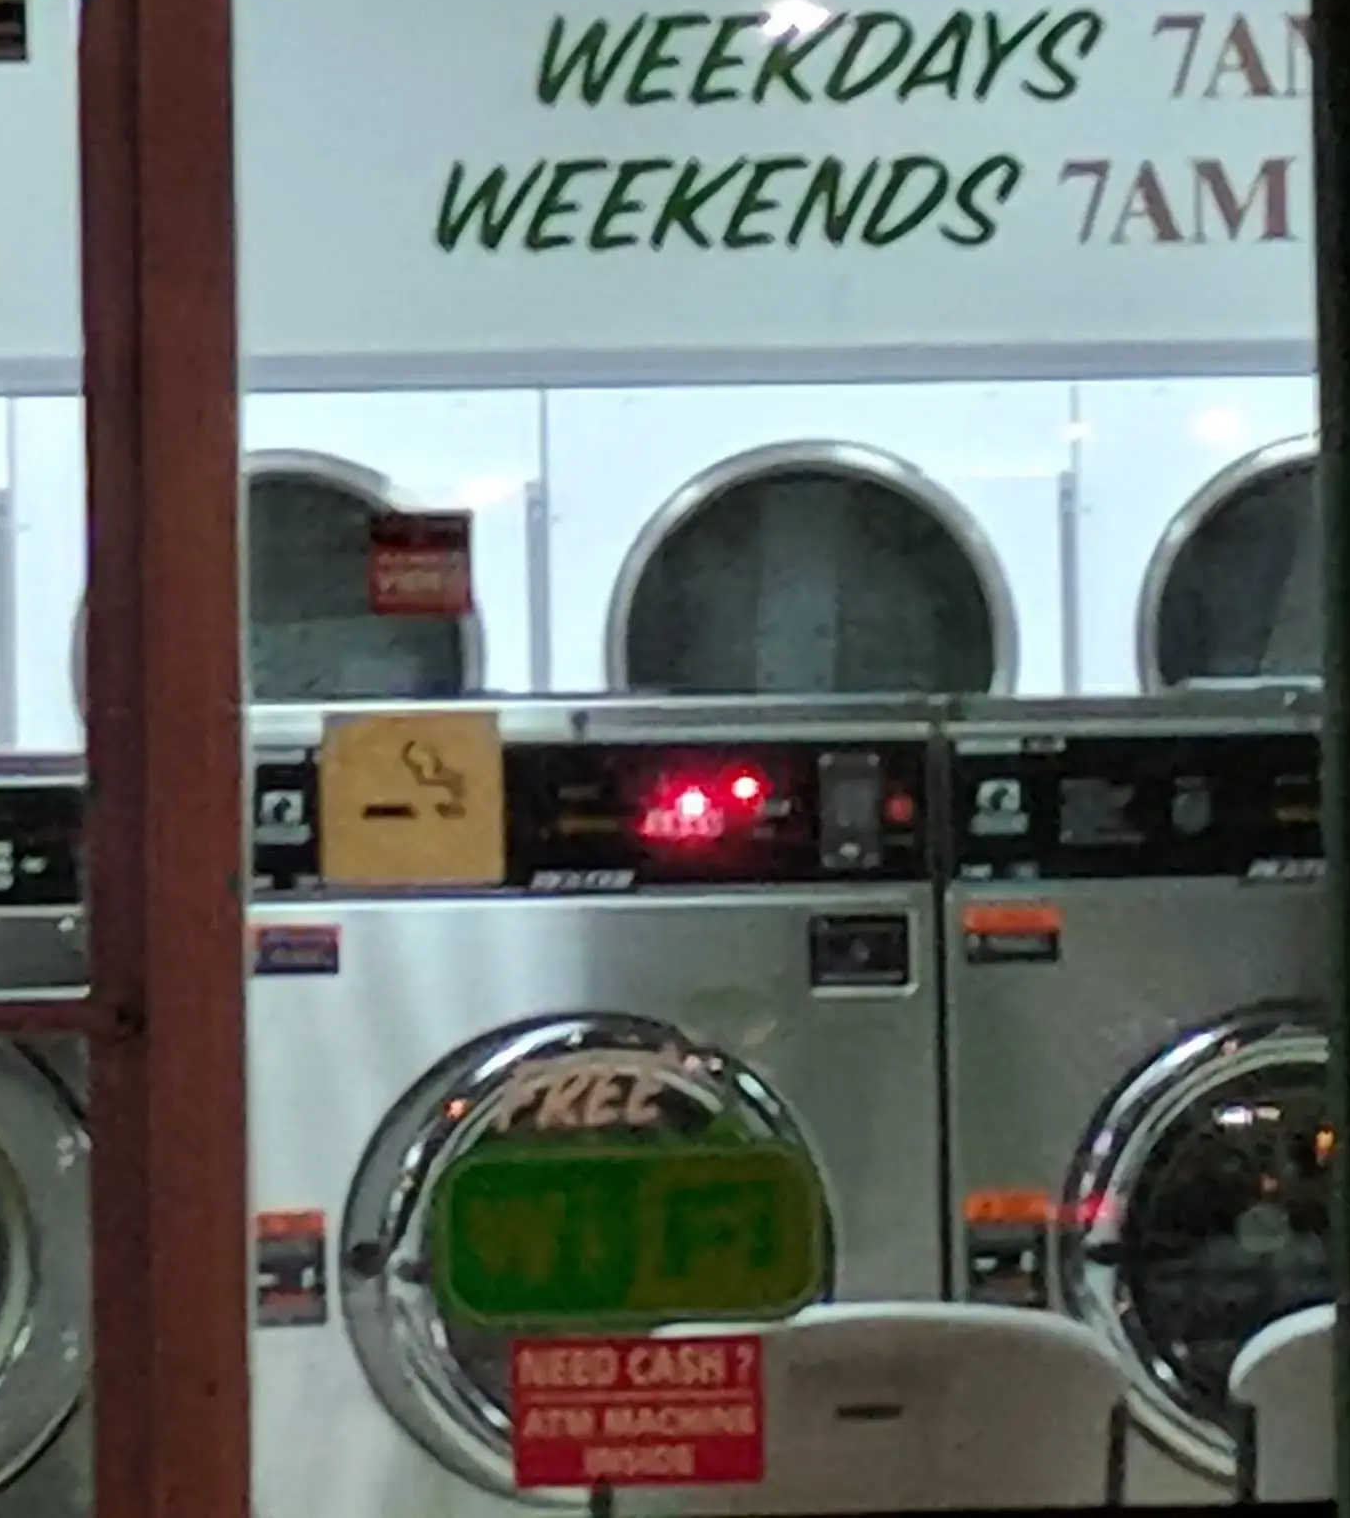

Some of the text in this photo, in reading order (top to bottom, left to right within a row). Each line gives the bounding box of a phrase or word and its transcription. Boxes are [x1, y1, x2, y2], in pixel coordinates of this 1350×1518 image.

[534, 5, 1105, 107] WEEKDAYS
[1151, 10, 1312, 99] 7A
[435, 154, 1299, 252] WEEKENDS 7AM
[518, 1346, 619, 1386] NEED
[627, 1345, 728, 1386] CASH
[523, 1406, 597, 1439] ATM
